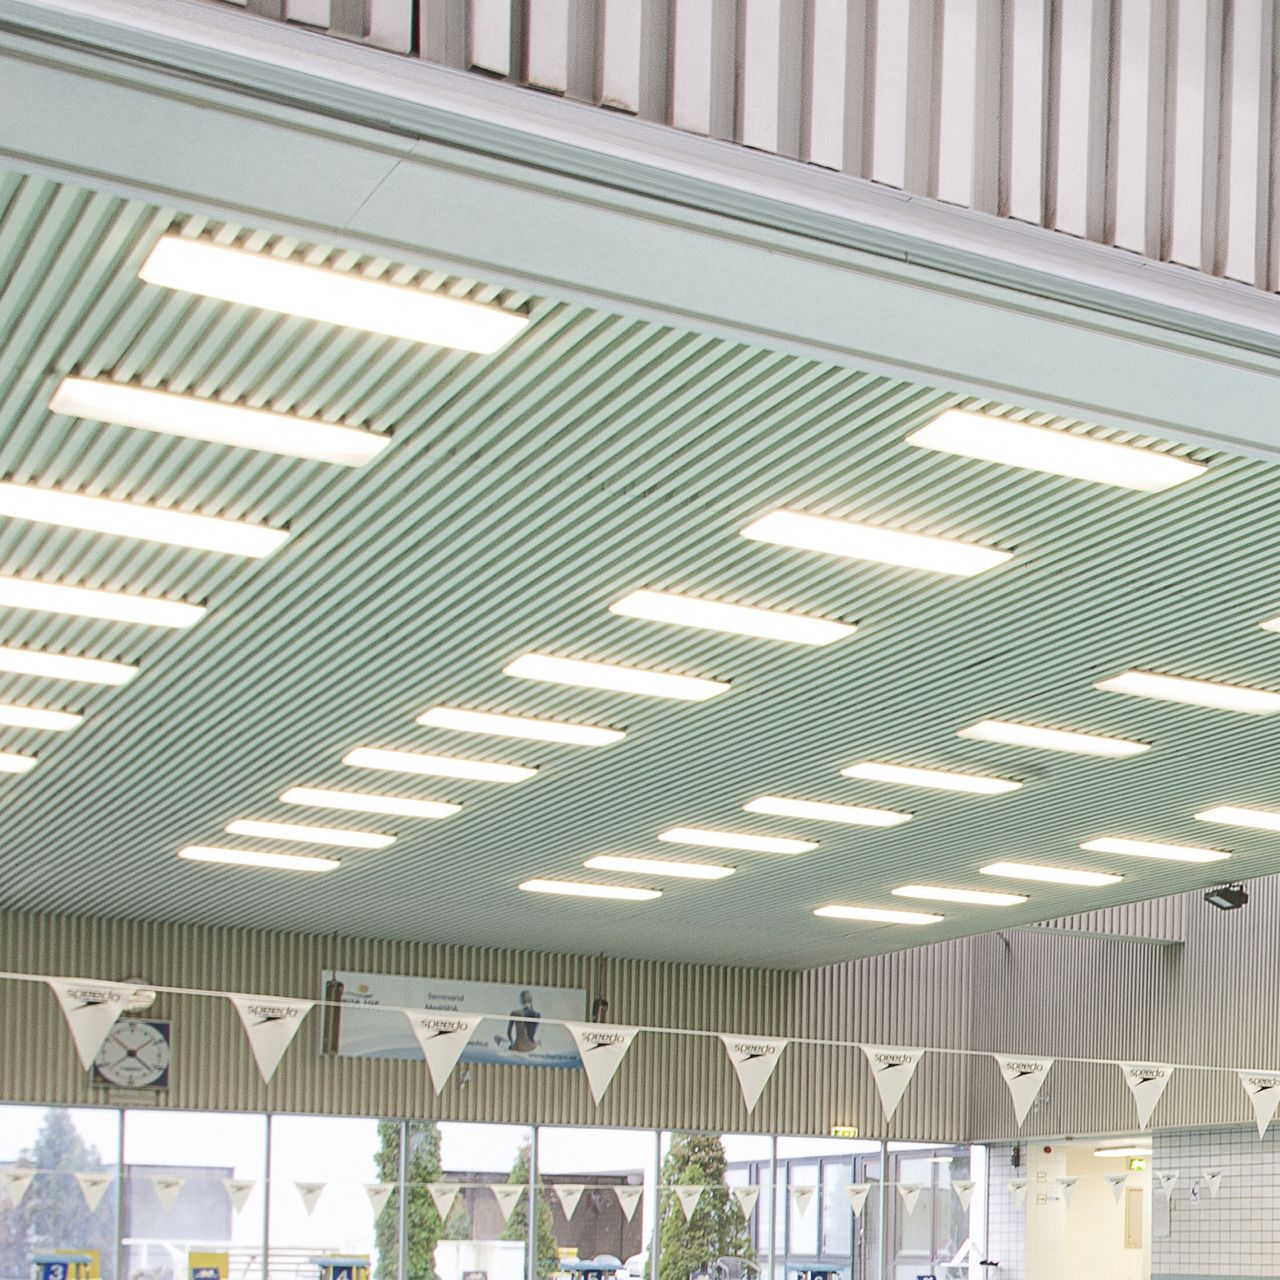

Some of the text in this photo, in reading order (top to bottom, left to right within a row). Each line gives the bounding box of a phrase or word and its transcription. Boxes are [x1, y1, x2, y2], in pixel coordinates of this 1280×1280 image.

[66, 989, 121, 1002] speedo
[248, 1005, 298, 1018] speedo
[421, 1019, 469, 1031] speedo
[582, 1031, 625, 1043] speedo
[734, 1043, 776, 1054] speedo
[874, 1053, 912, 1064] speedo
[1007, 1061, 1043, 1072] speedo
[1130, 1067, 1165, 1078] speedo
[1248, 1077, 1280, 1086] speedo
